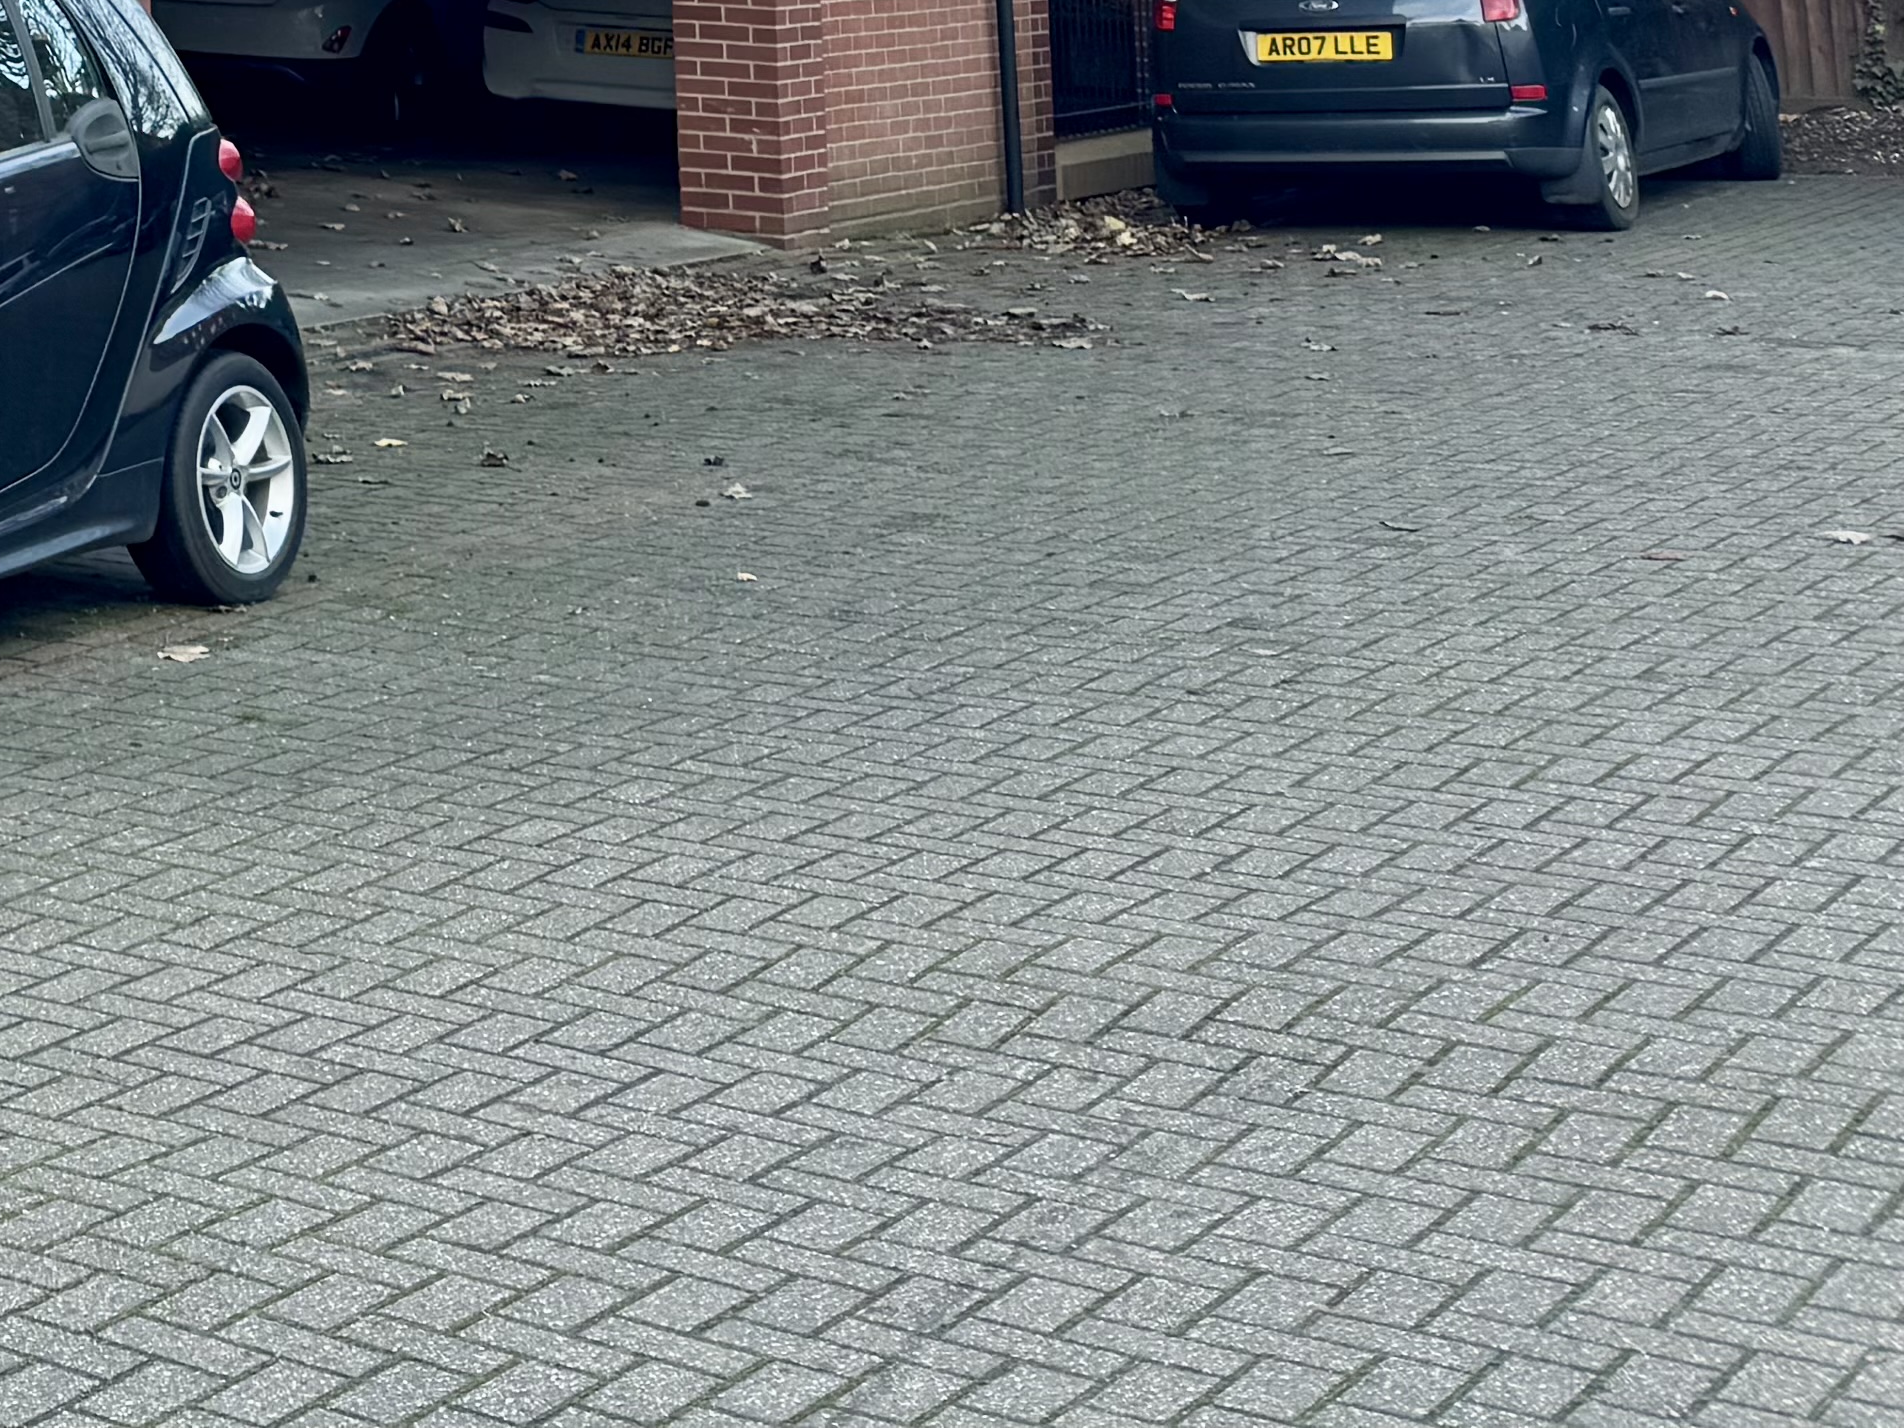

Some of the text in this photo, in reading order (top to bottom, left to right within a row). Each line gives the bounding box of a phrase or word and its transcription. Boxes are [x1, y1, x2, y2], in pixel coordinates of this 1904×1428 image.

[591, 33, 631, 52] AX14
[1268, 35, 1381, 56] AR07 LLE
